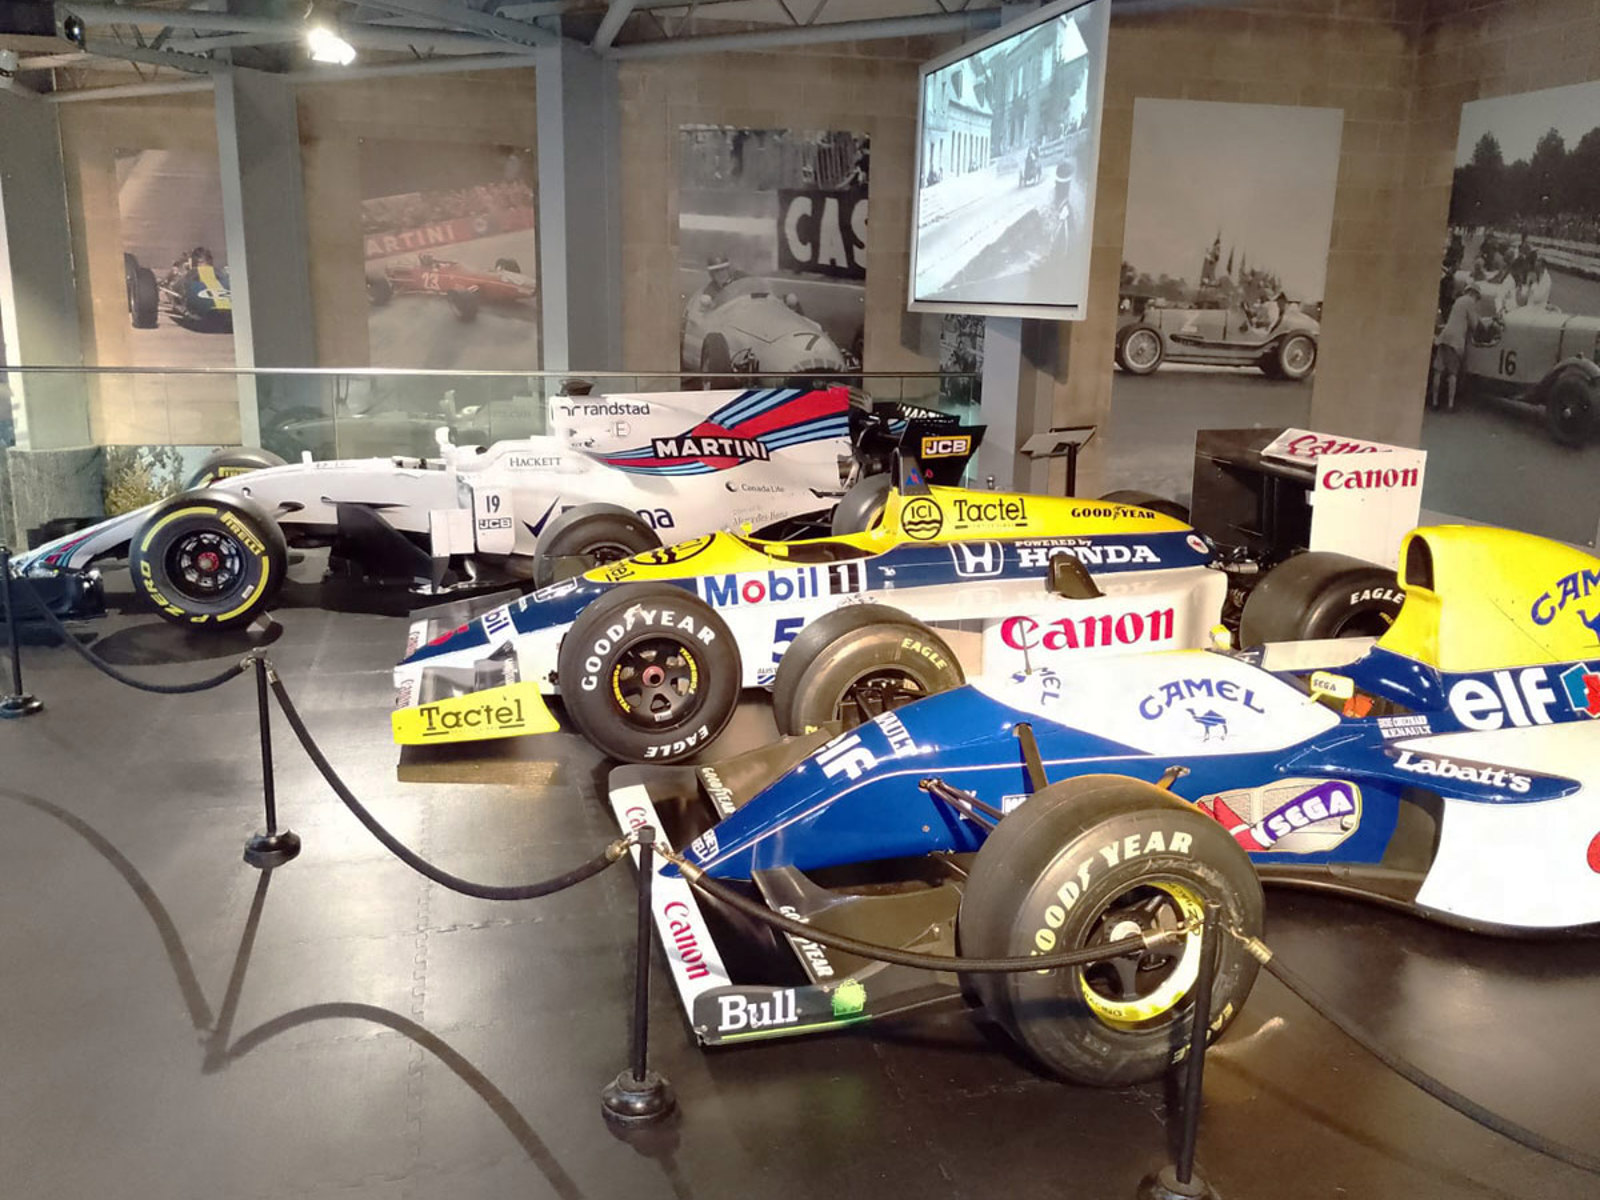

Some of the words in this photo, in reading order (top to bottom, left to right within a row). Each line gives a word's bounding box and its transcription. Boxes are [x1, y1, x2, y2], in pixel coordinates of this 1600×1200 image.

[793, 332, 820, 351] 7
[1498, 349, 1517, 376] 16
[584, 402, 650, 416] randstad
[655, 436, 769, 460] MARTINI
[926, 441, 967, 454] JCB
[509, 456, 562, 468] HACKETT
[1322, 467, 1419, 490] Canon
[485, 495, 501, 513] 19
[911, 505, 933, 519] ICI
[953, 498, 1028, 523] Tactel
[479, 519, 512, 529] JCB
[1015, 539, 1076, 547] POWERED
[140, 560, 185, 617] ZERO
[704, 566, 820, 607] Mobil
[1350, 587, 1406, 605] EAGLE
[1001, 608, 1174, 651] Canon
[901, 638, 948, 670] EAGLE
[1313, 679, 1336, 691] SEGA
[1139, 678, 1265, 720] CAMEL
[1449, 667, 1557, 731] elf
[420, 699, 525, 731] Tactel
[644, 724, 709, 758] EAGLE
[1393, 751, 1532, 793] Labatt's
[1267, 790, 1353, 839] SEGA
[664, 901, 710, 980] Canon
[718, 989, 798, 1031] Bull
